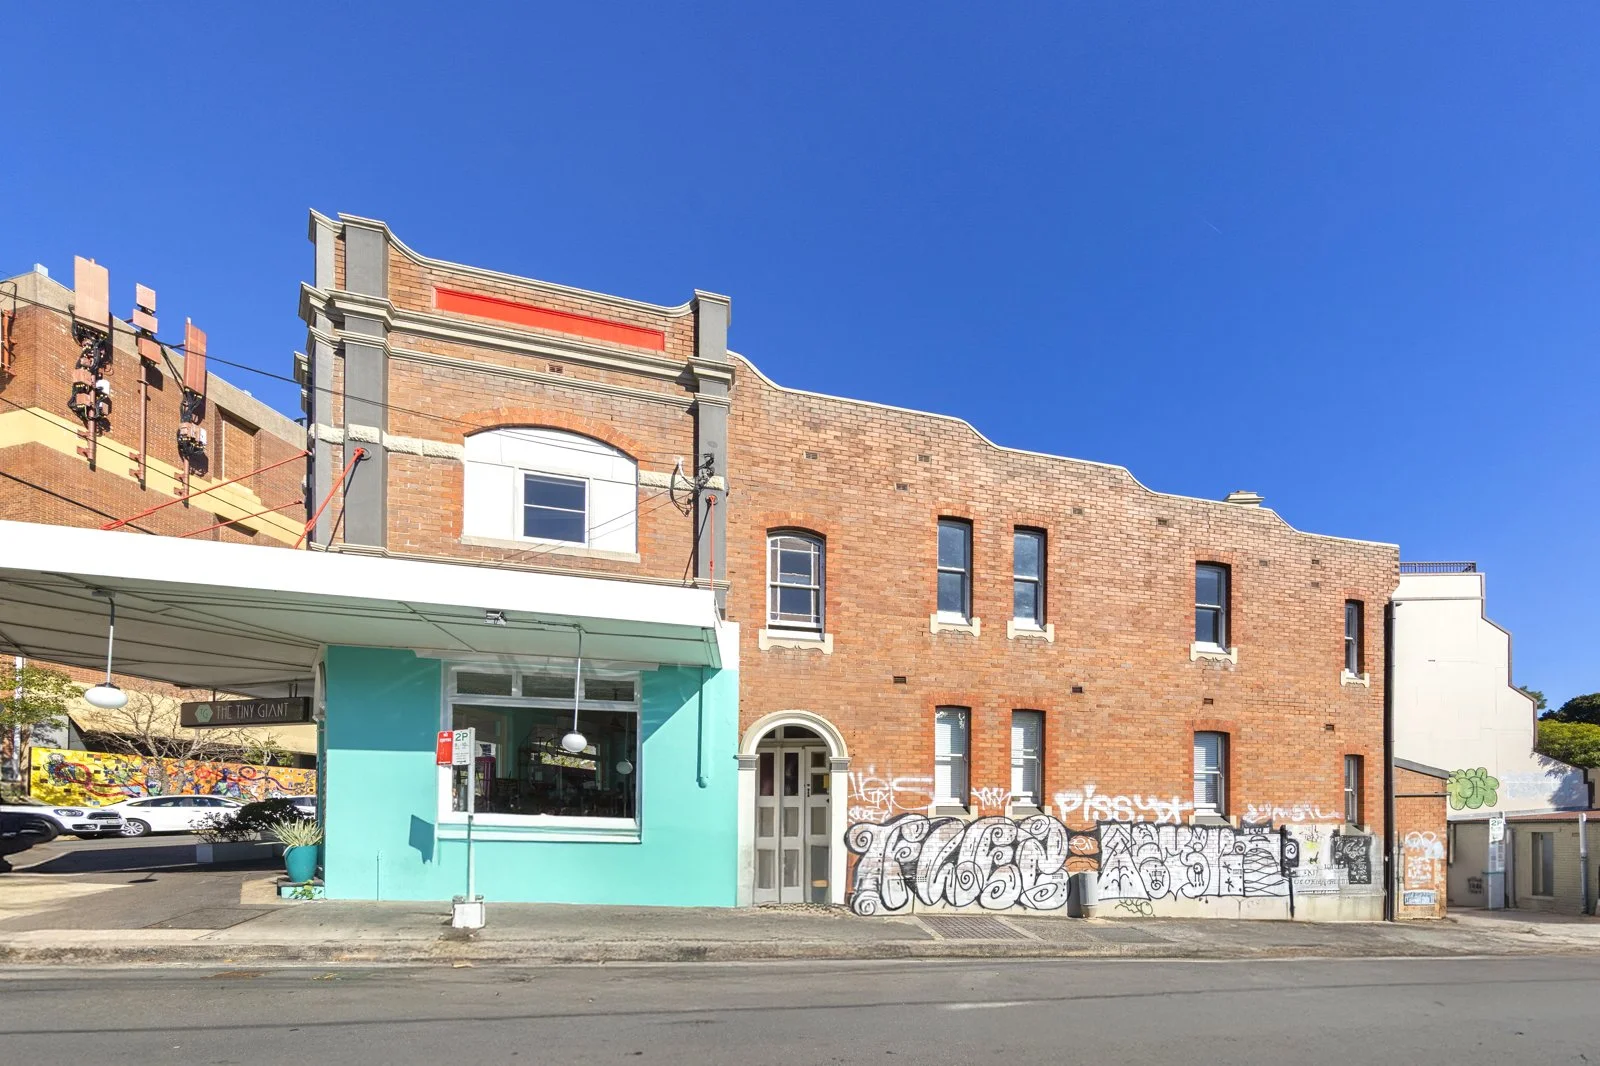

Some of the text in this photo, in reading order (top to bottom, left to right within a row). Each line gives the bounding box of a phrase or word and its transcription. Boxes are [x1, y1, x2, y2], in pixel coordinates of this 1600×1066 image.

[216, 702, 289, 720] THE TINY GIANT
[455, 732, 469, 742] 2P
